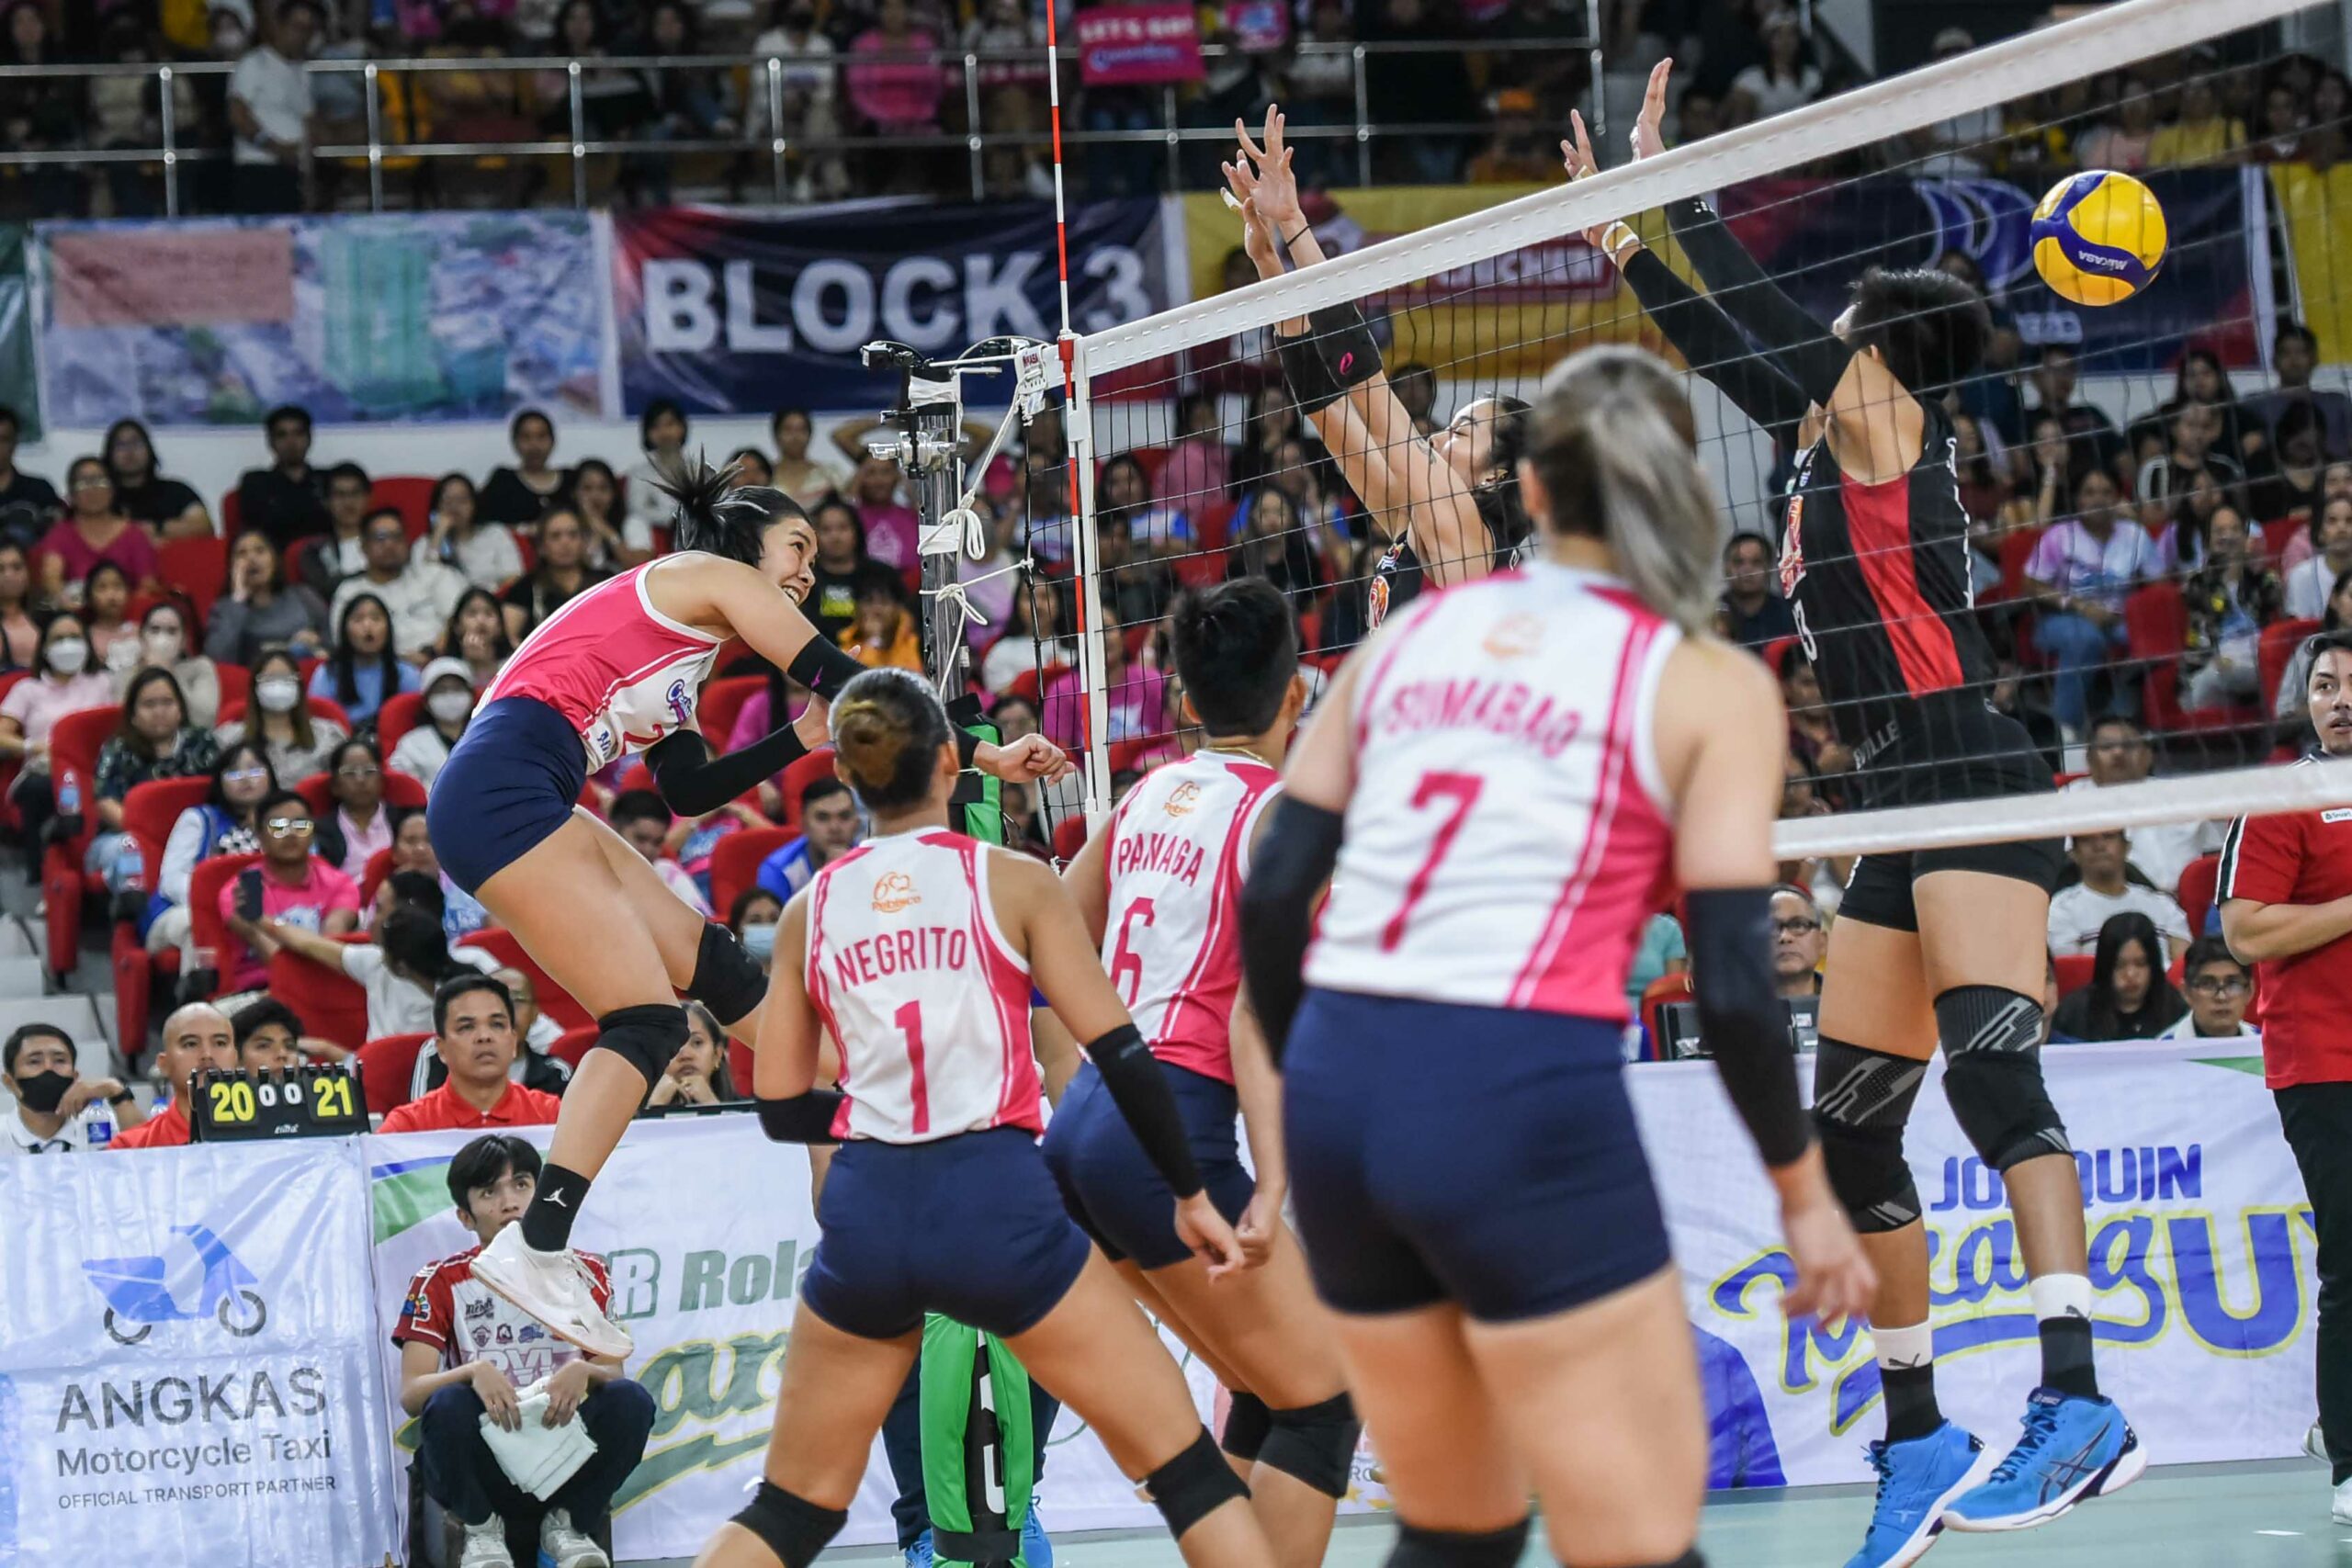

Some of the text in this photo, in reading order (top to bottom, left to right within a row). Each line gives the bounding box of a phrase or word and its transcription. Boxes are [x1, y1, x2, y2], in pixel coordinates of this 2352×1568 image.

[2077, 250, 2129, 272] MIKASA
[645, 245, 1153, 353] BLOCK 3
[1118, 833, 1205, 888] PANAGA
[1381, 769, 1485, 953] 7
[834, 927, 967, 993] NEGRITO
[1111, 897, 1156, 1011] 6
[894, 999, 930, 1135] 1
[209, 1080, 256, 1122] 20
[258, 1083, 277, 1107] 0
[284, 1082, 302, 1105] 0
[312, 1076, 354, 1117] 21
[55, 1367, 327, 1433] ANGKAS
[56, 1429, 332, 1477] Motorcycle Taxi
[58, 1475, 336, 1509] OFFICIAL TRANSPORT PARTNER
